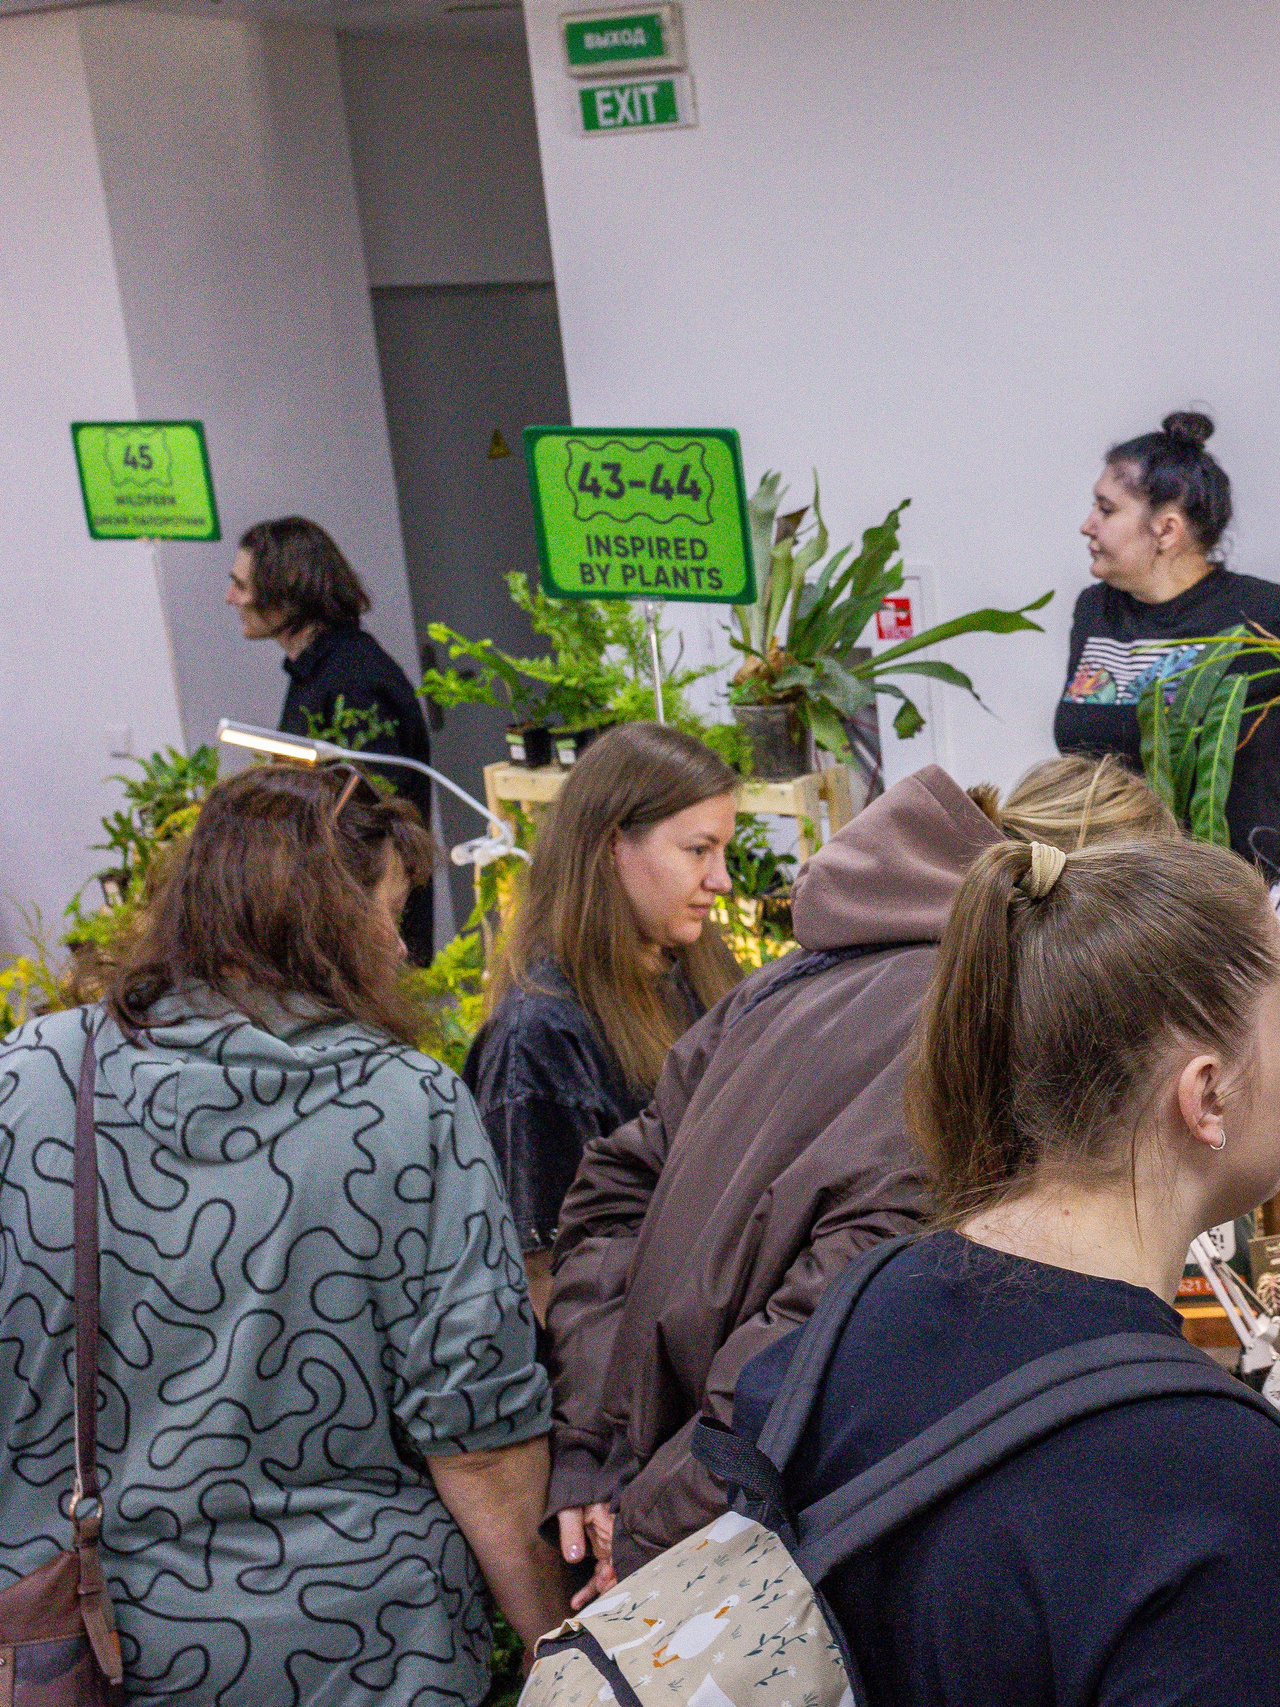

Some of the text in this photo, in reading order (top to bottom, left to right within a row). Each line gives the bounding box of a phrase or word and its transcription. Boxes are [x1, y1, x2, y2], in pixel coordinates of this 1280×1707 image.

[594, 85, 659, 127] EXIT
[123, 443, 153, 470] 45
[577, 461, 702, 501] 43-44
[585, 534, 708, 561] INSPIRED
[580, 562, 723, 590] BY PLANTS
